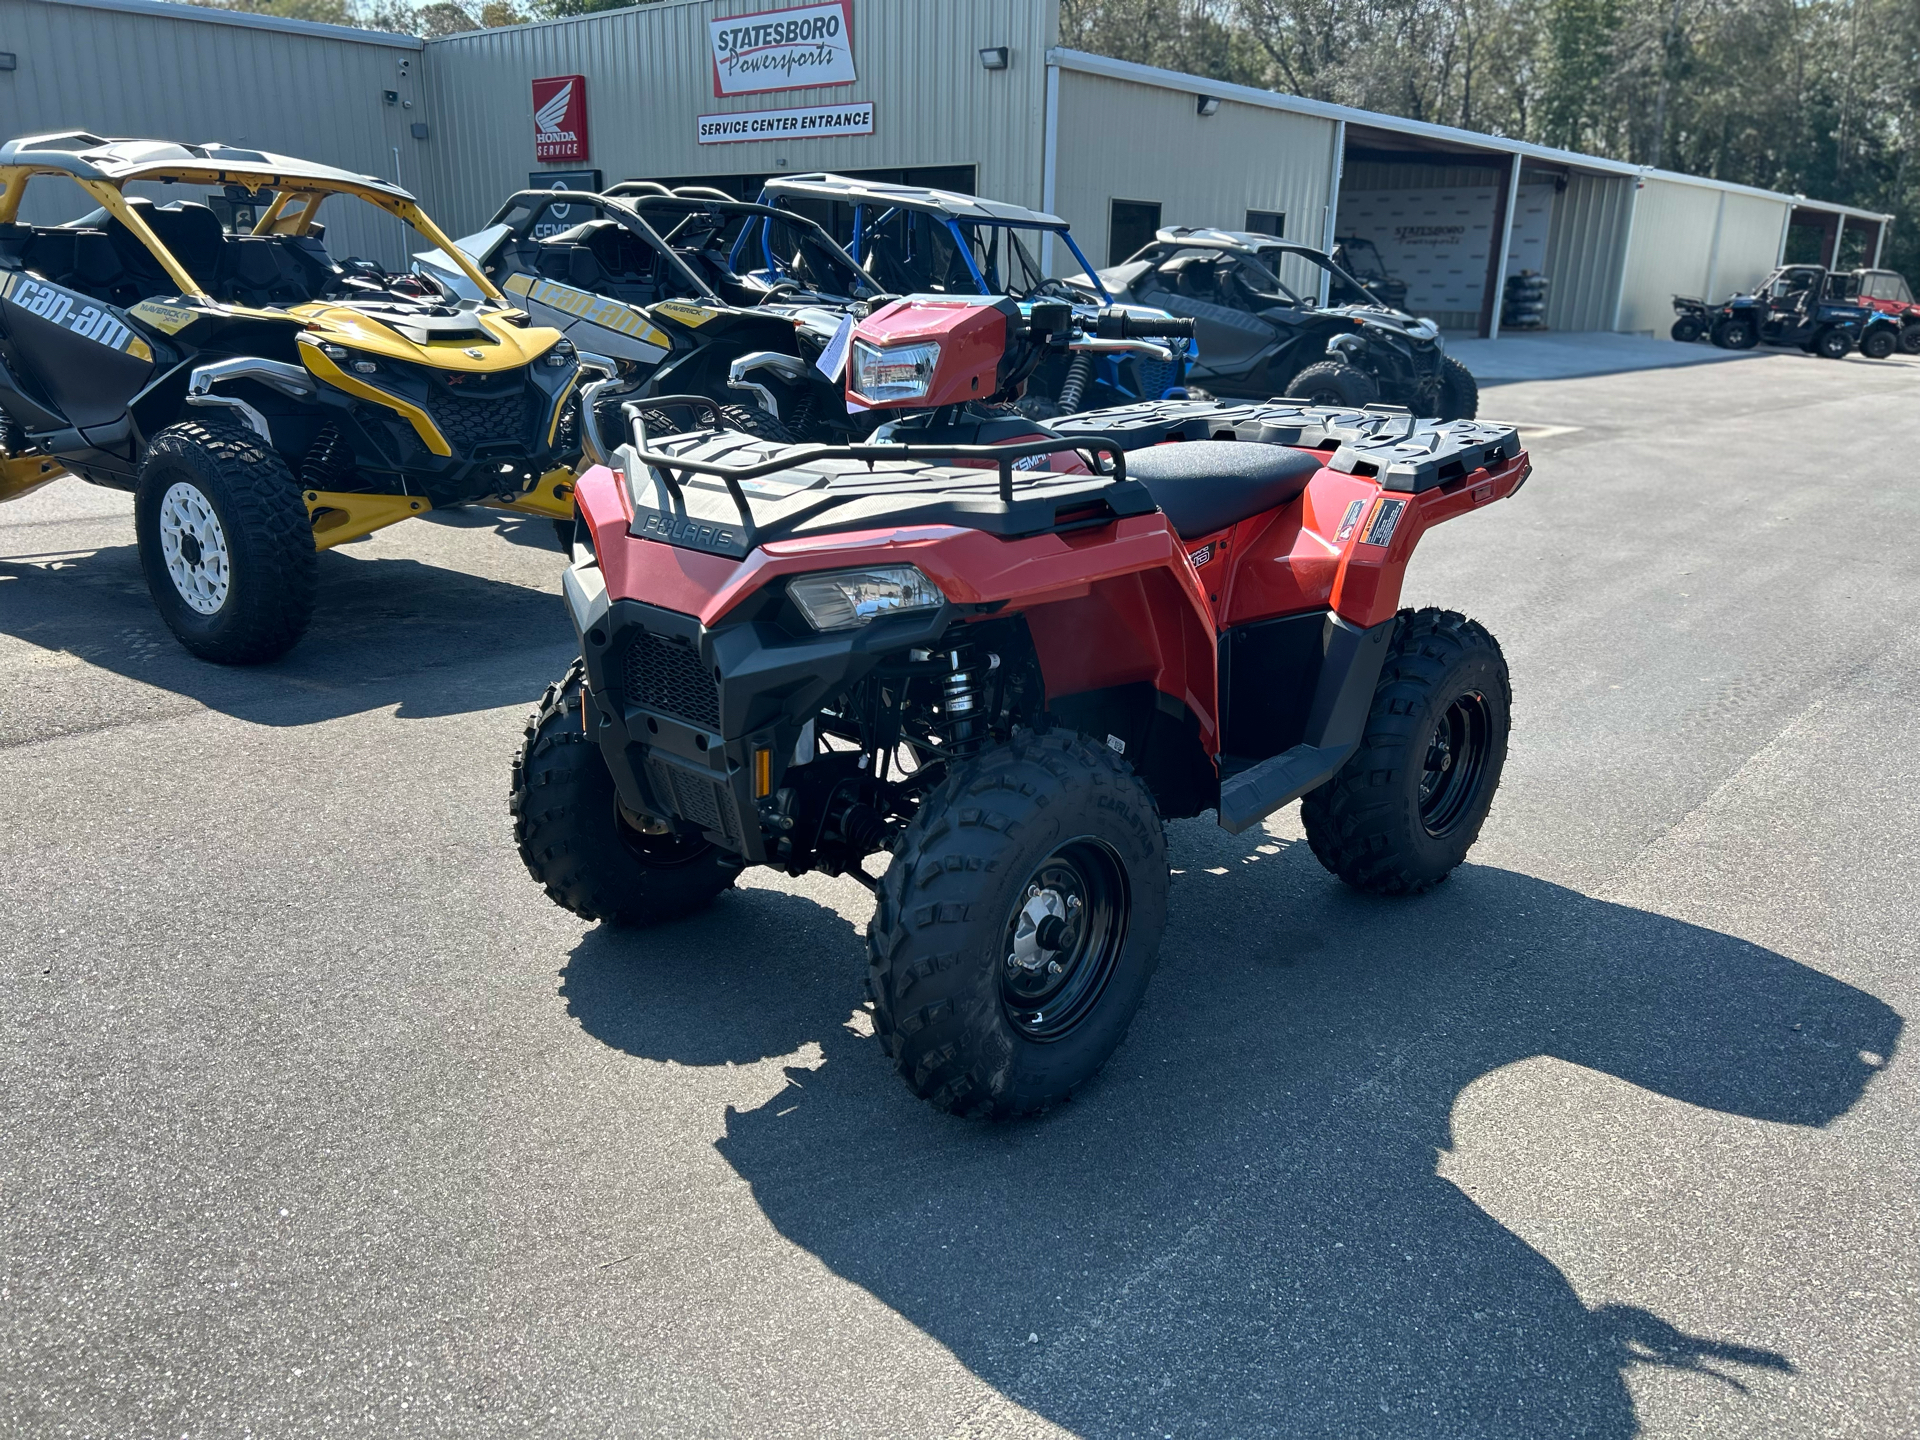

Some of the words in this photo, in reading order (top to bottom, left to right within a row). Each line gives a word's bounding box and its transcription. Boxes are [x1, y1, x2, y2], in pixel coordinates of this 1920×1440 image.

[718, 15, 839, 51] STATESBORO
[728, 42, 834, 77] Powersports
[536, 131, 577, 143] HONDA
[701, 121, 748, 136] SERVICE
[751, 117, 798, 132] CENTER
[801, 111, 869, 128] ENTRANCE
[537, 144, 577, 156] SERVICE
[12, 279, 131, 350] can-am
[140, 303, 181, 319] MAVERICK
[538, 284, 650, 338] can-am
[664, 303, 701, 316] MAVERICK
[642, 514, 734, 548] POLARIS
